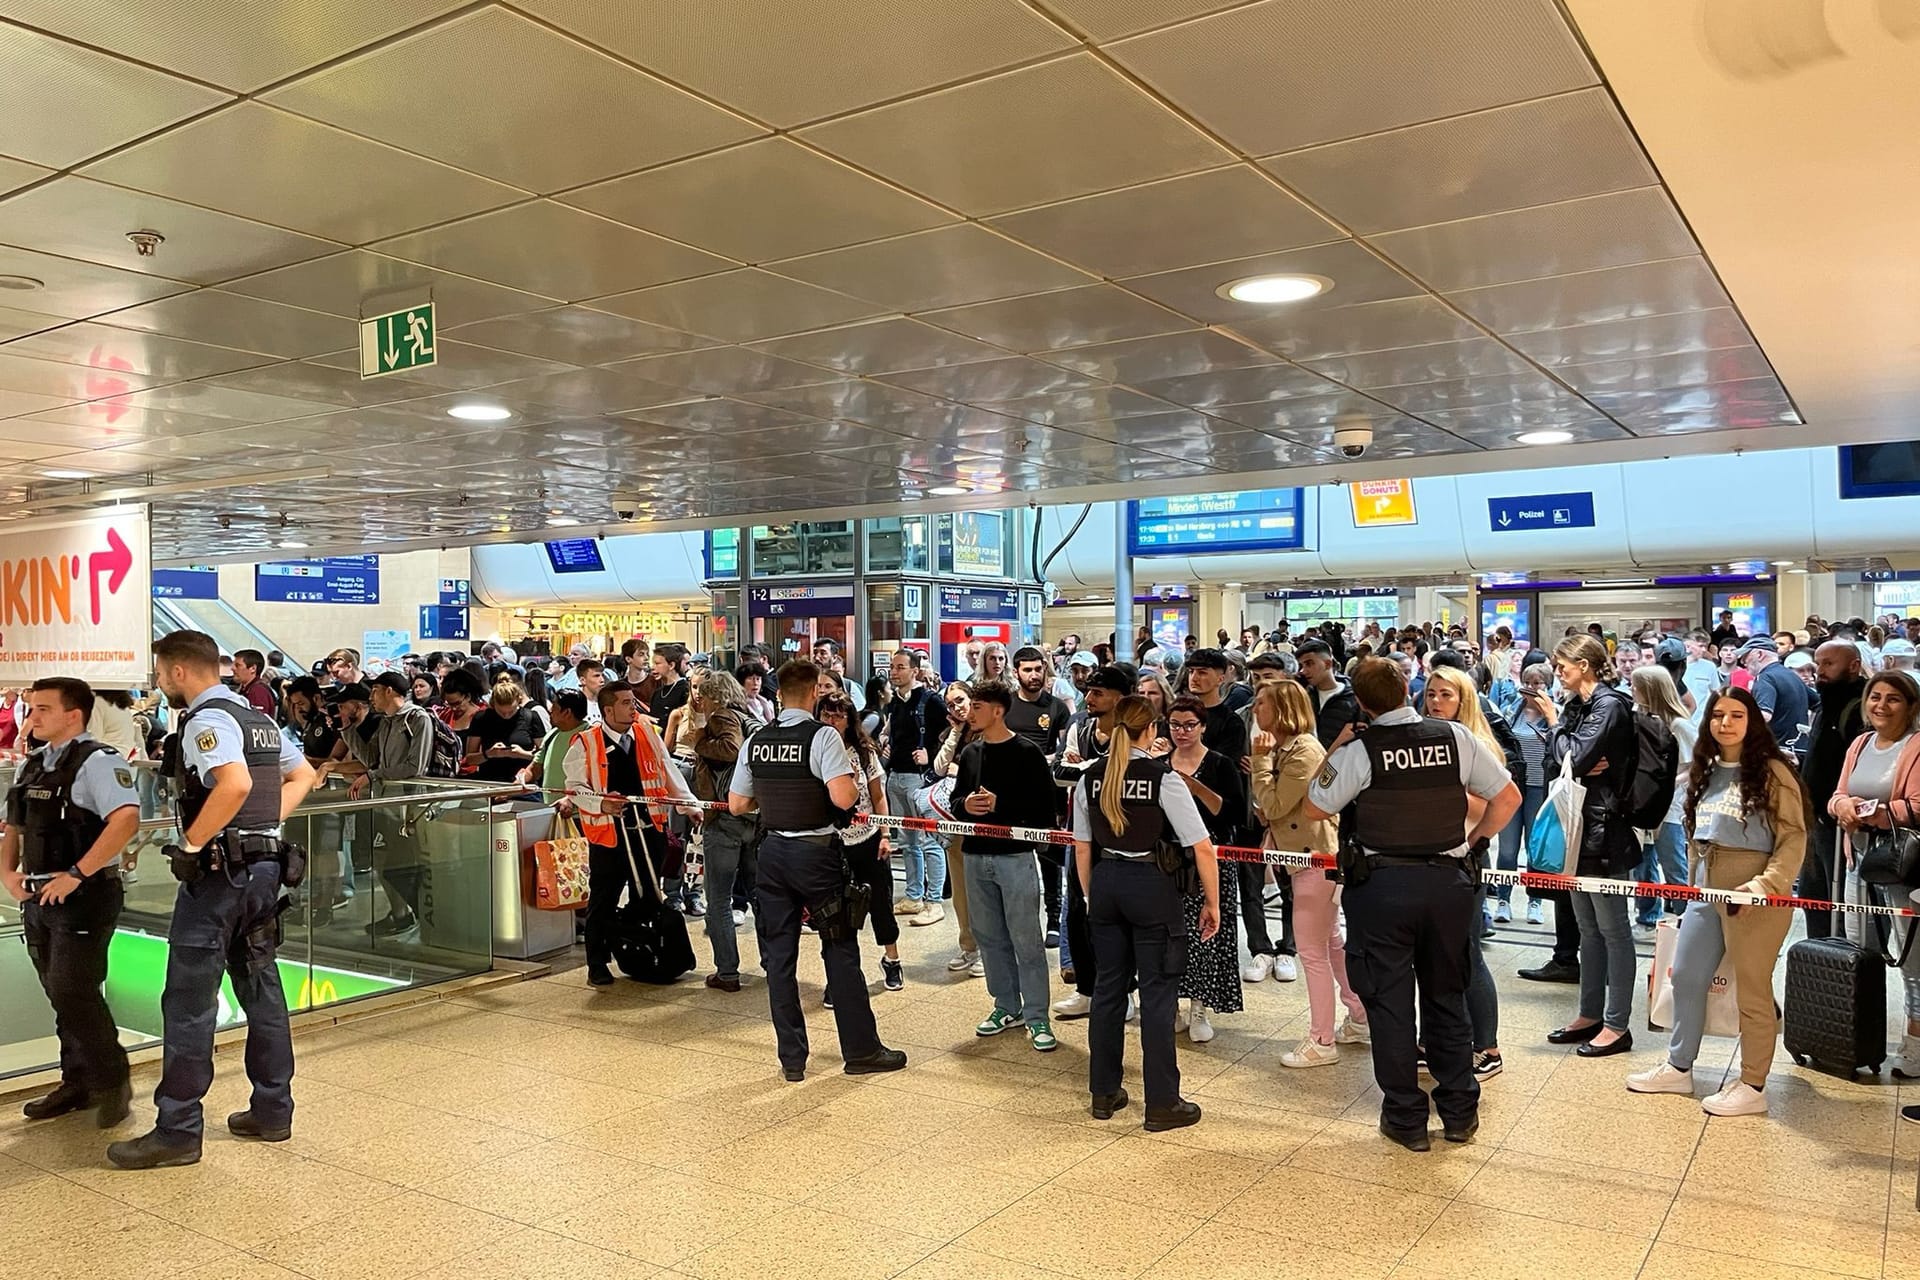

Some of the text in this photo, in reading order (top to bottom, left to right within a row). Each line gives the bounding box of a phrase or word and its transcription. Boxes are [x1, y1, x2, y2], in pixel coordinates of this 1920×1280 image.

[1363, 486, 1399, 494] DONUTS
[0, 554, 80, 626] KIN'
[752, 588, 767, 601] 1-2
[908, 590, 918, 607] U
[561, 612, 673, 635] GERRY WEBER
[40, 651, 57, 662] HIER
[80, 650, 135, 661] REISEZENTRUM
[752, 744, 802, 763] POLIZEI
[1382, 744, 1452, 771] POLIZEI
[1092, 779, 1153, 800] PIZEI
